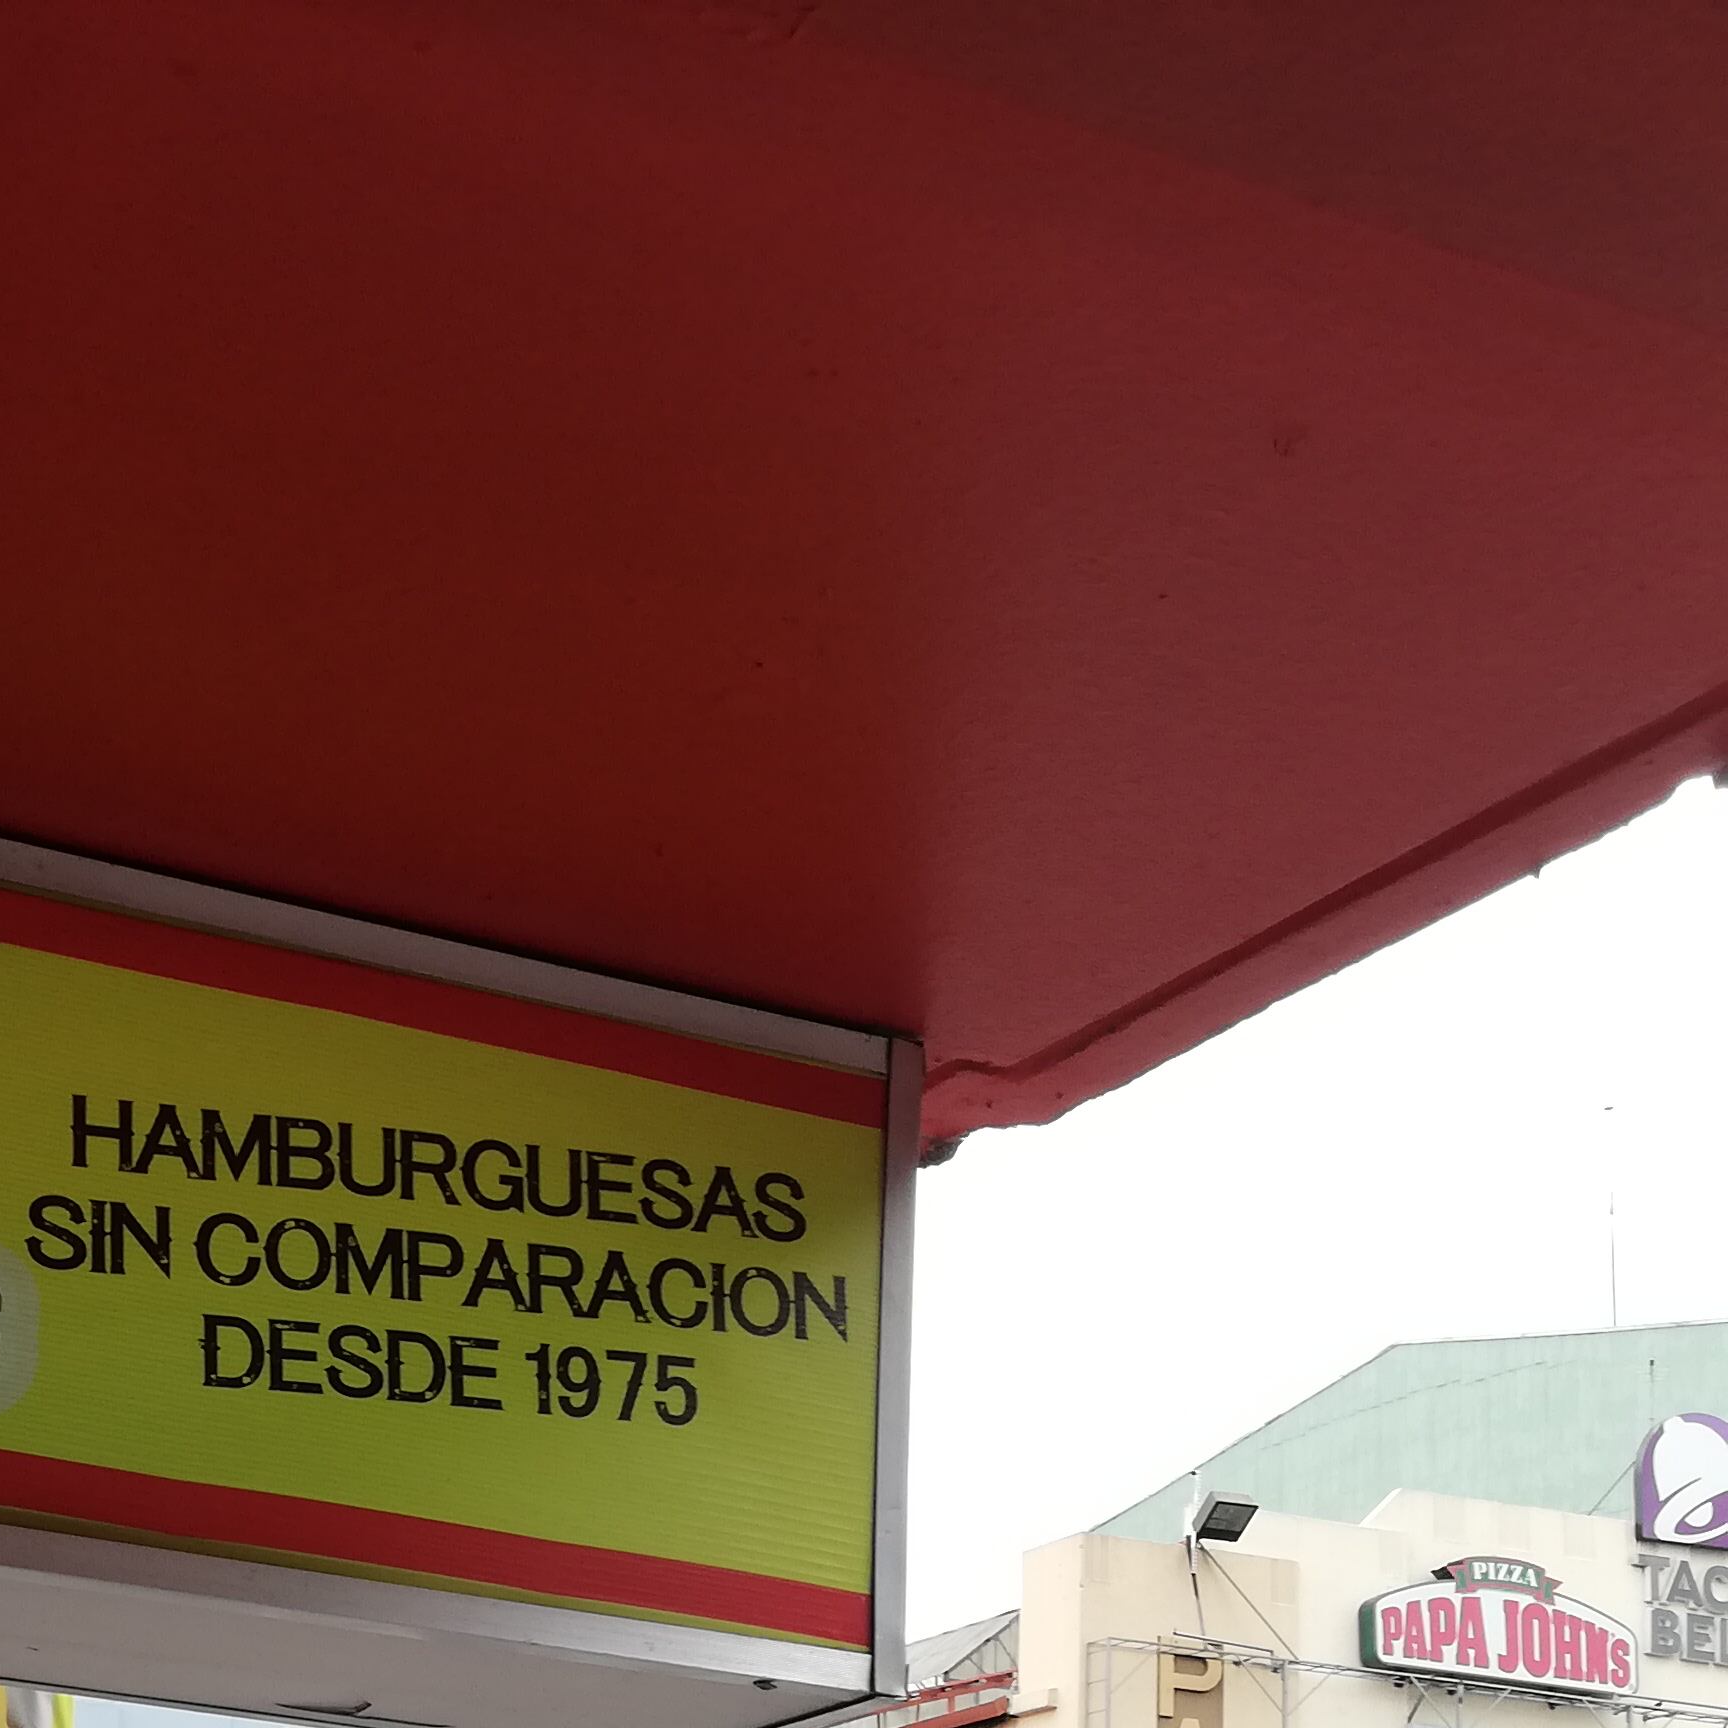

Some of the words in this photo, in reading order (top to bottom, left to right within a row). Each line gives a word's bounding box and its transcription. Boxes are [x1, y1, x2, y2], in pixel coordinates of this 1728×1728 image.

[71, 1094, 808, 1244] HAMBURGUESAS
[24, 1195, 172, 1280] SIN
[195, 1212, 850, 1344] COMPARACION
[198, 1314, 506, 1412] DESDE
[525, 1341, 700, 1427] 1975
[1472, 1561, 1540, 1589] PIZZA
[1633, 1552, 1728, 1615] TAC
[1381, 1596, 1490, 1669] PAPA
[1647, 1608, 1728, 1666] BE
